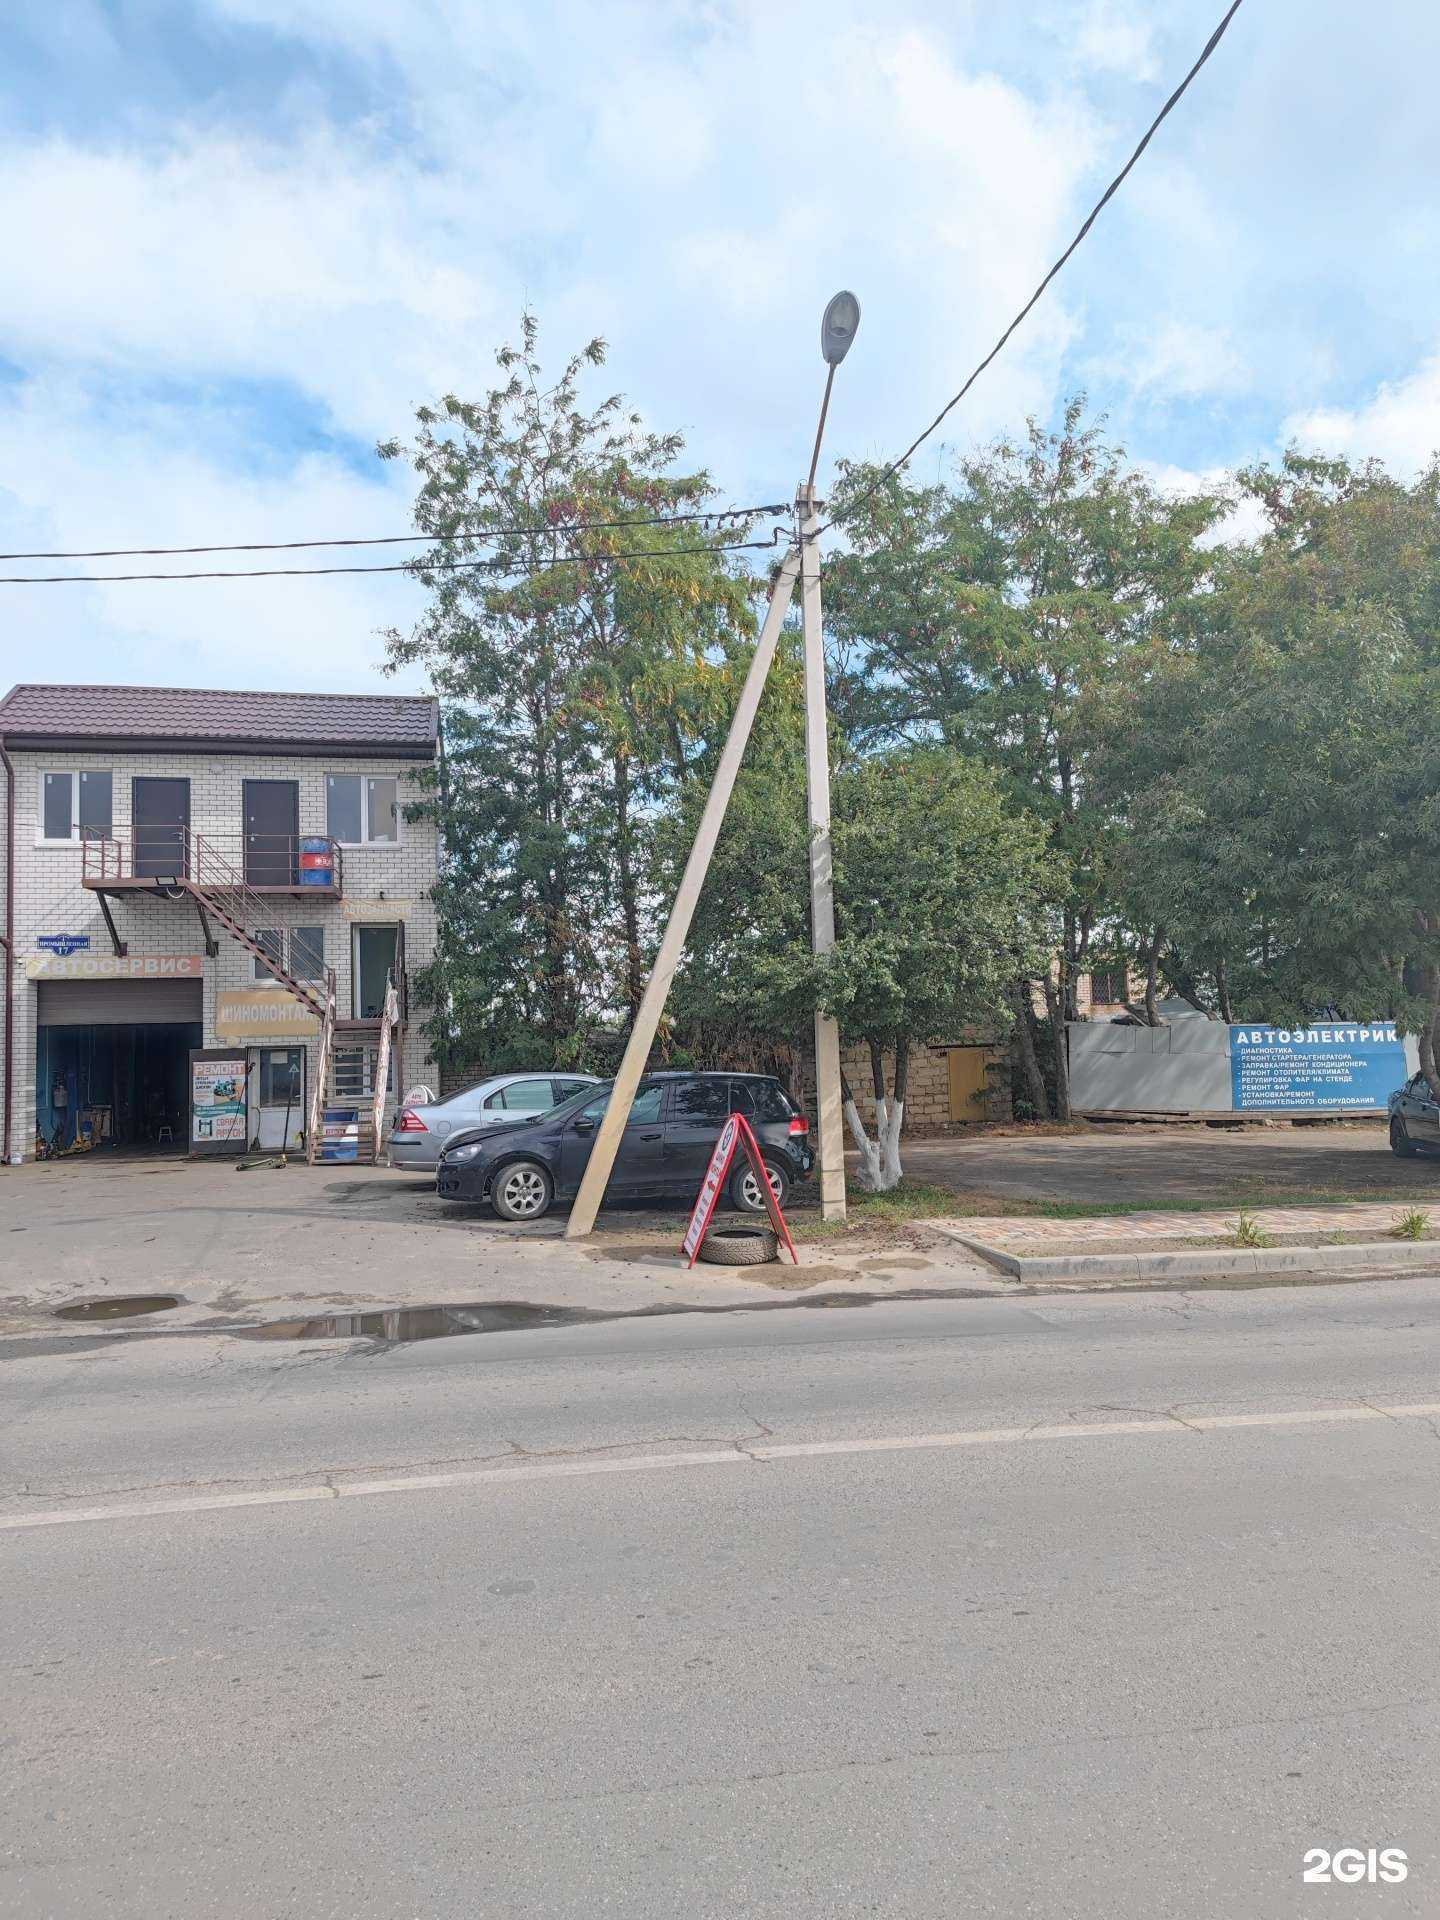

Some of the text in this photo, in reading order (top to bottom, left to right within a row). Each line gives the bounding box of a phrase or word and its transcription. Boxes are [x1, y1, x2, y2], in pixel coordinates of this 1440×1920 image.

[1237, 1030, 1398, 1044] АВТОЭЛЕКТРИК
[195, 1064, 243, 1076] РЕМОНТ
[1317, 1097, 1375, 1105] ОБОРУДОВАНИЯ
